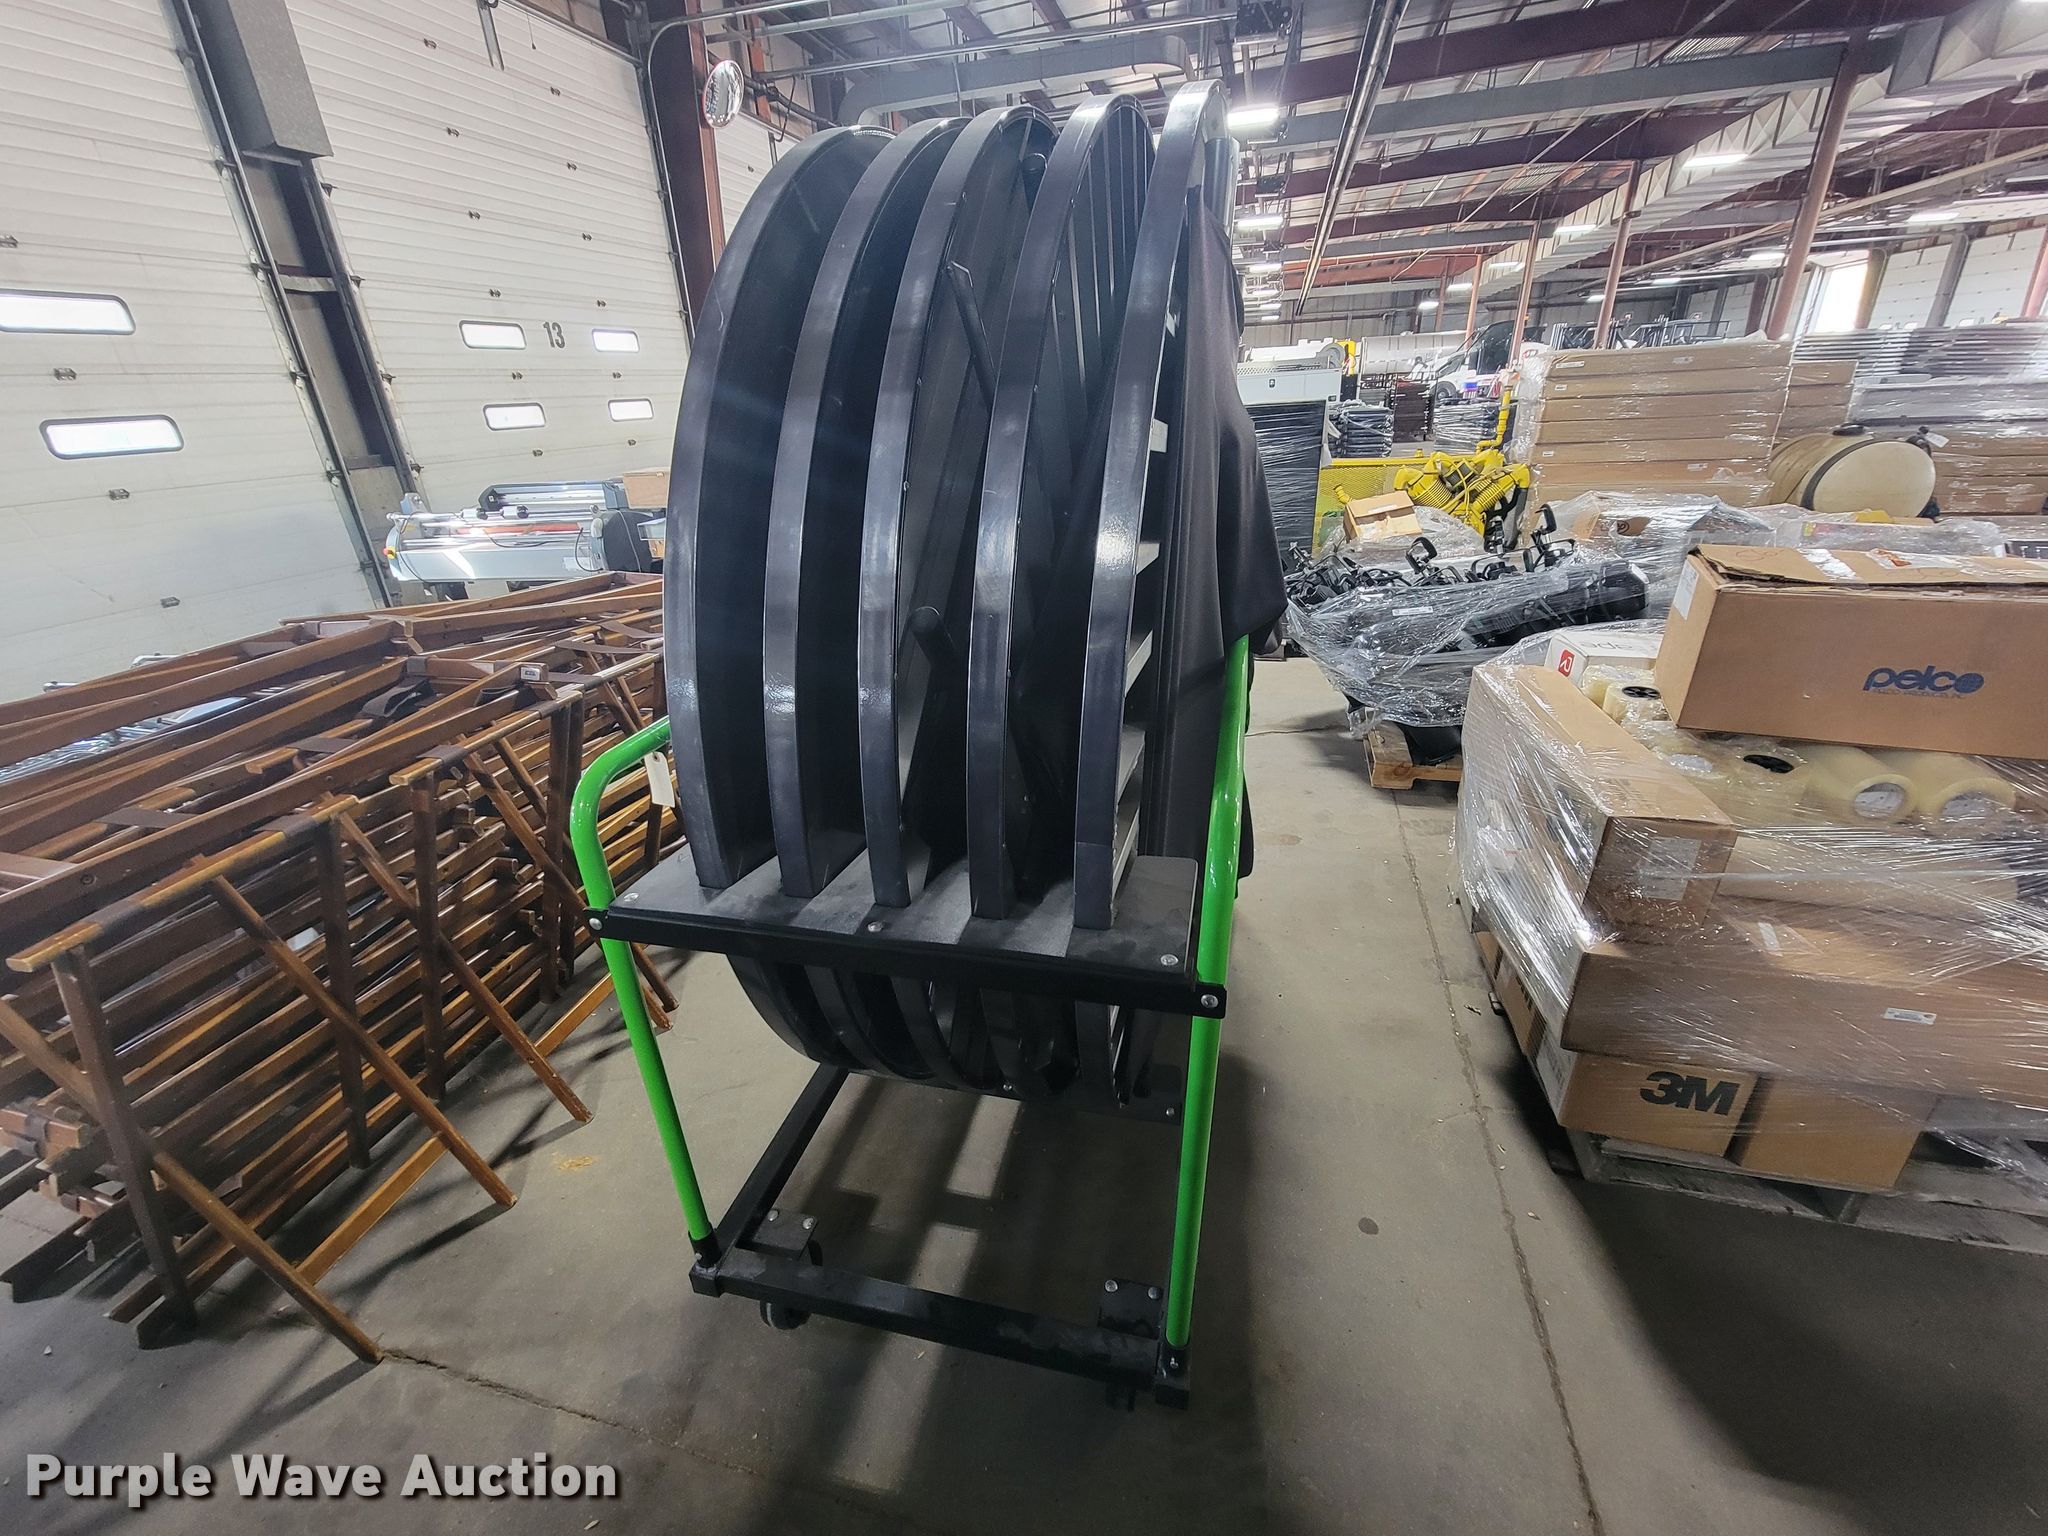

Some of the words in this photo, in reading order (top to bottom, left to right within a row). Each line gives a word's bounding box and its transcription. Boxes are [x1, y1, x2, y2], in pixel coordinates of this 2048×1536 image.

[543, 321, 566, 349] 13
[1863, 665, 1985, 694] pelco
[1640, 1070, 1741, 1117] 3M
